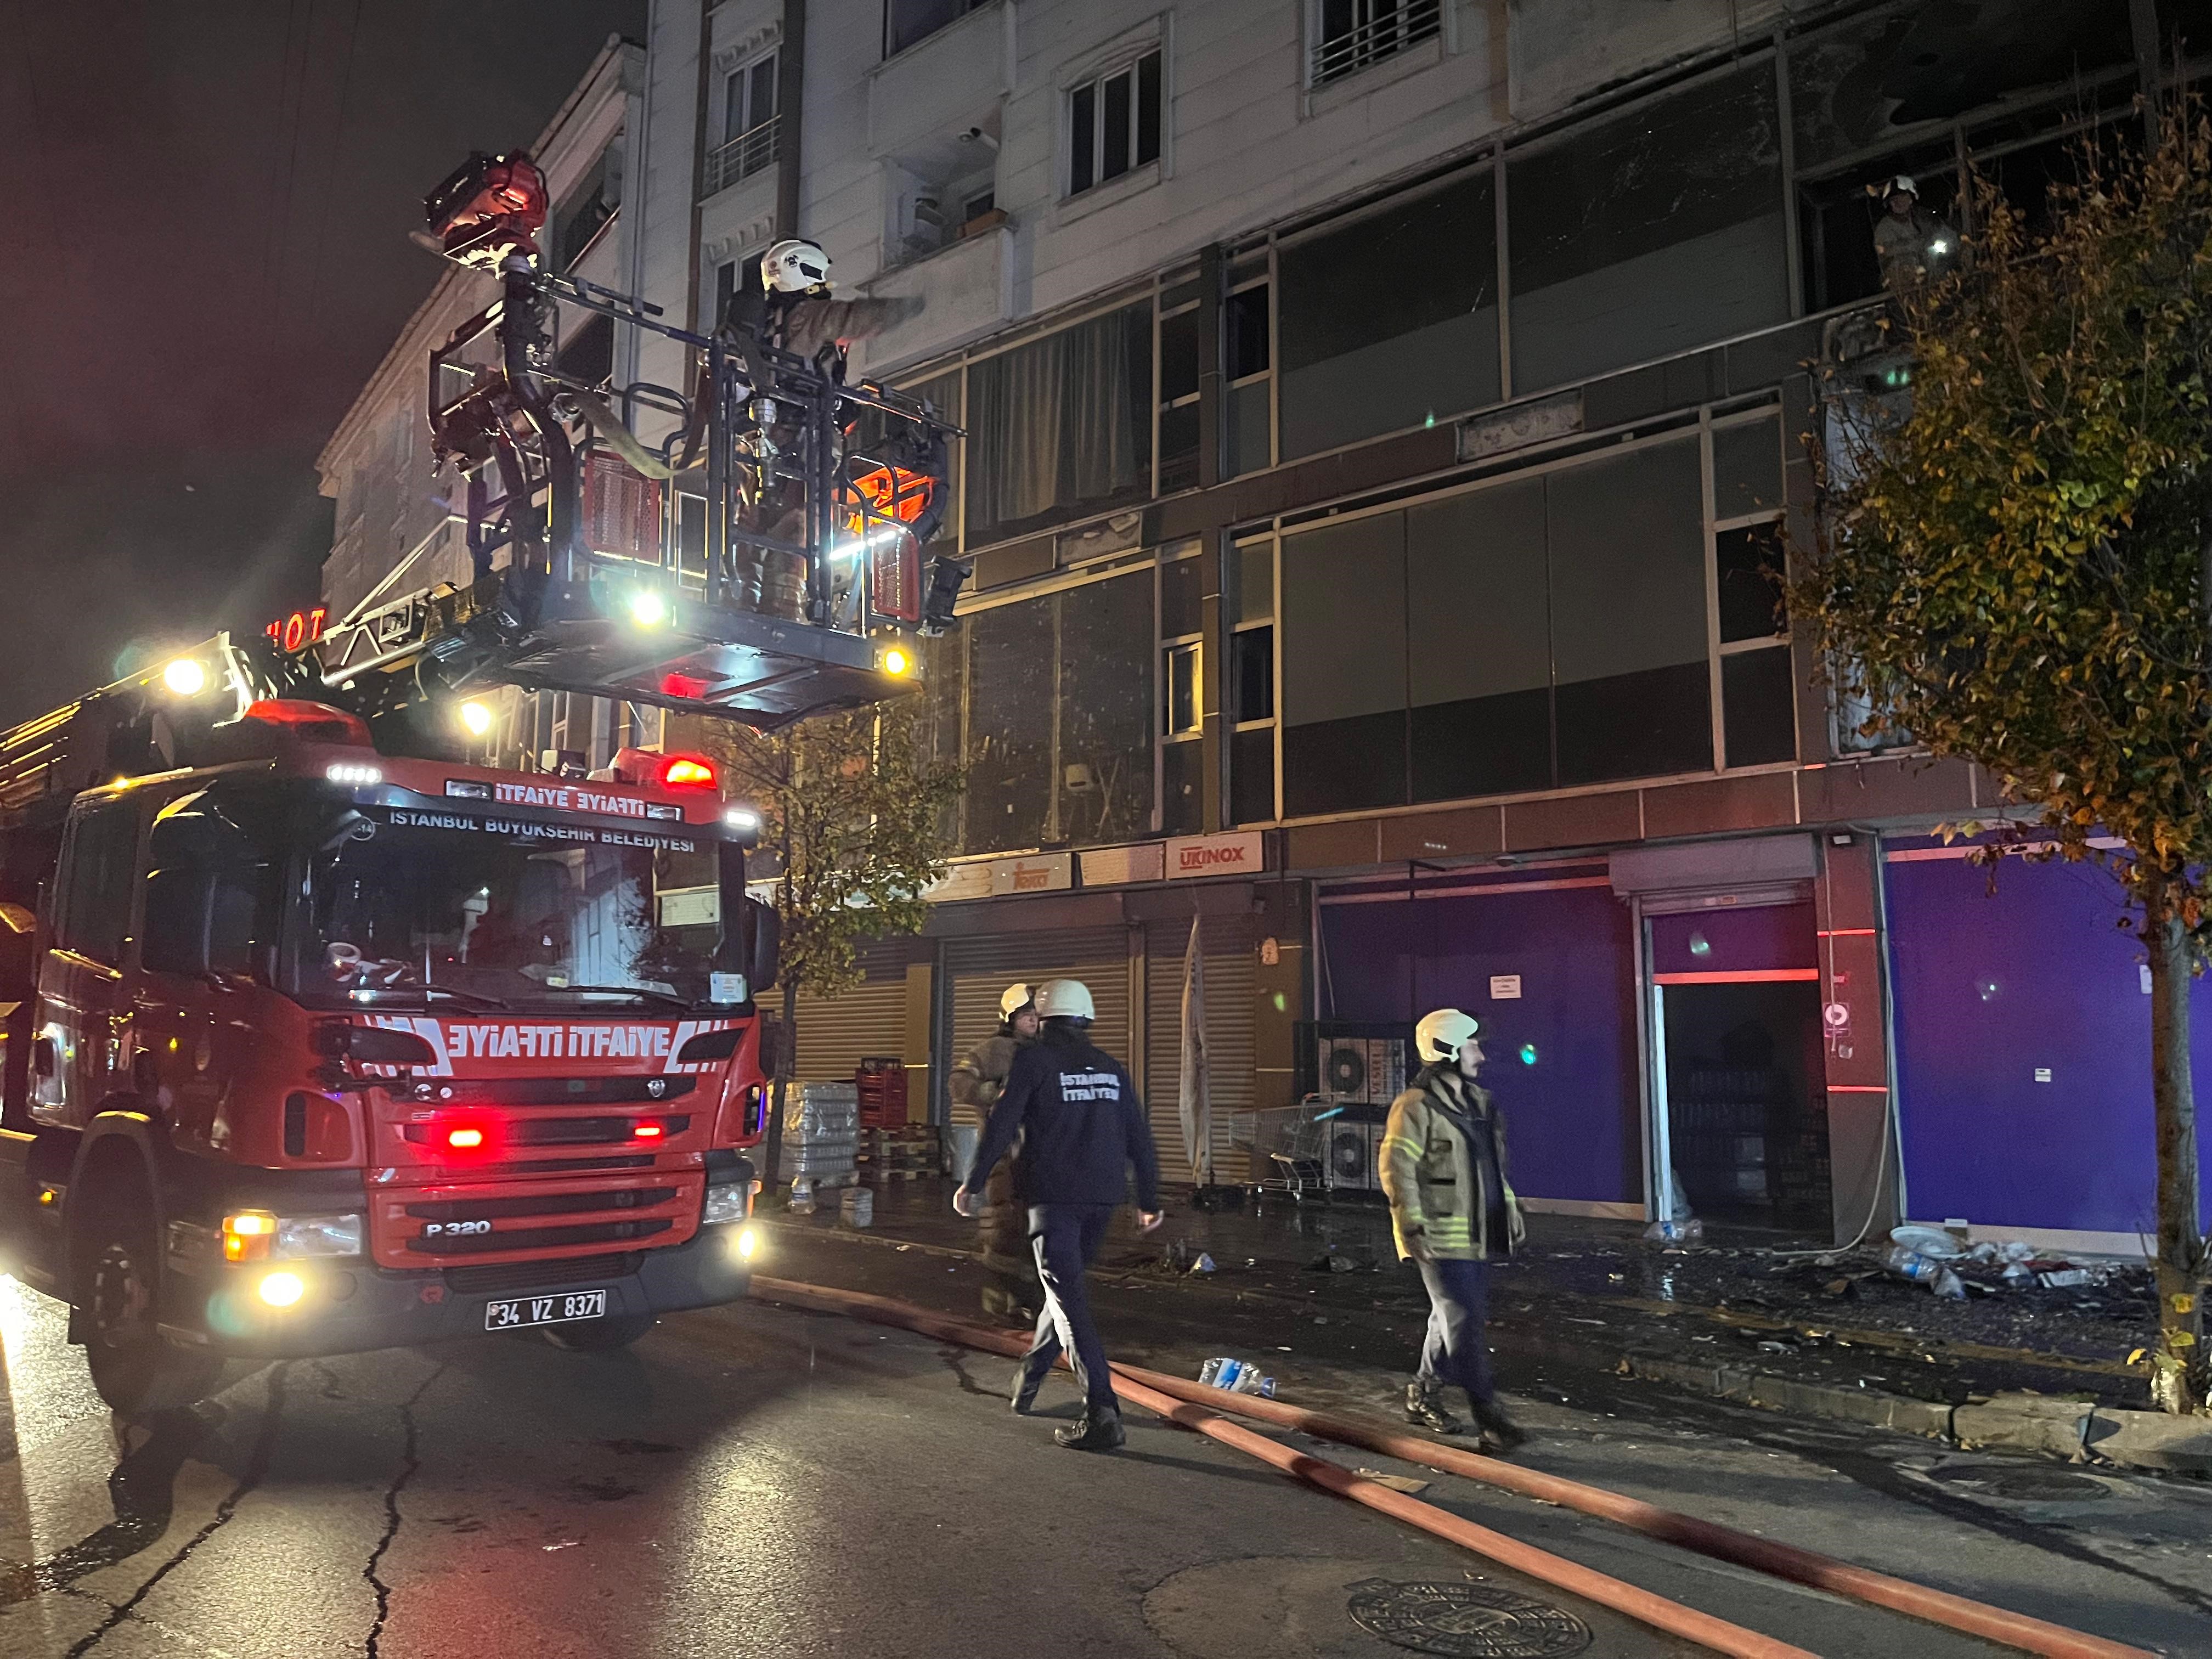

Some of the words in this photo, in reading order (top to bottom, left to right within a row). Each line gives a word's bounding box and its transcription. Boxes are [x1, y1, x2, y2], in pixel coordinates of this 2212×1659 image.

[1180, 847, 1244, 868] UKINOX
[427, 1223, 442, 1238] P
[445, 1221, 491, 1235] 320
[498, 1303, 519, 1325] 34
[532, 1299, 553, 1321] VZ
[564, 1293, 602, 1317] 8371
